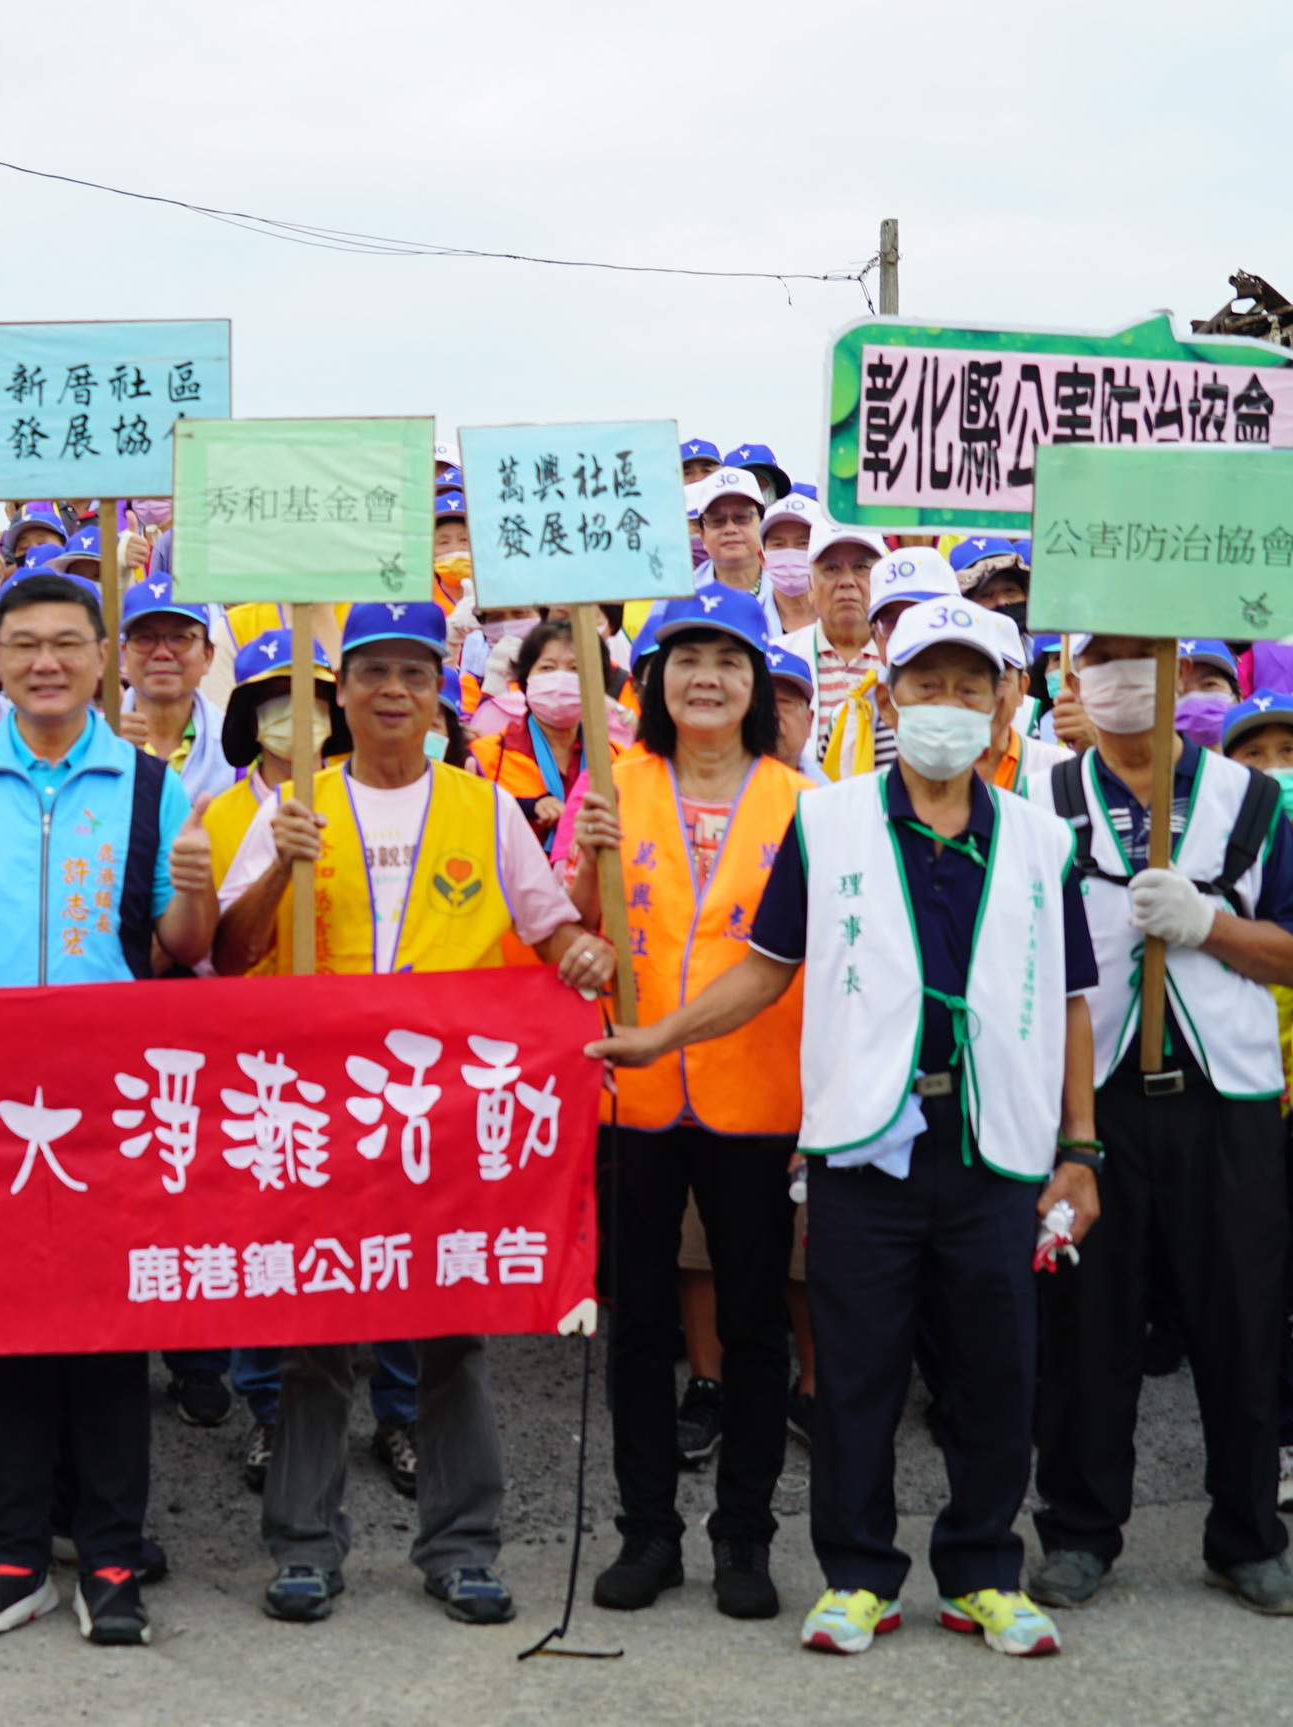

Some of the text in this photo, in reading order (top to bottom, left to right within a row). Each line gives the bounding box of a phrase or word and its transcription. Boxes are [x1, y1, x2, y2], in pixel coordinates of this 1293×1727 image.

[4, 361, 202, 407] 新厝社區
[6, 411, 185, 460] 發展協
[497, 450, 642, 503] 萬興社區
[203, 484, 399, 524] 秀和基金會
[497, 507, 650, 559] 發展協會
[1044, 519, 1293, 568] 公害防治協會
[928, 606, 973, 630] 30
[62, 857, 91, 956] 許志宏
[626, 841, 658, 1002] 萬興社
[837, 871, 865, 996] 理事長
[127, 1226, 548, 1303] 鹿港鎮公所 廣告
